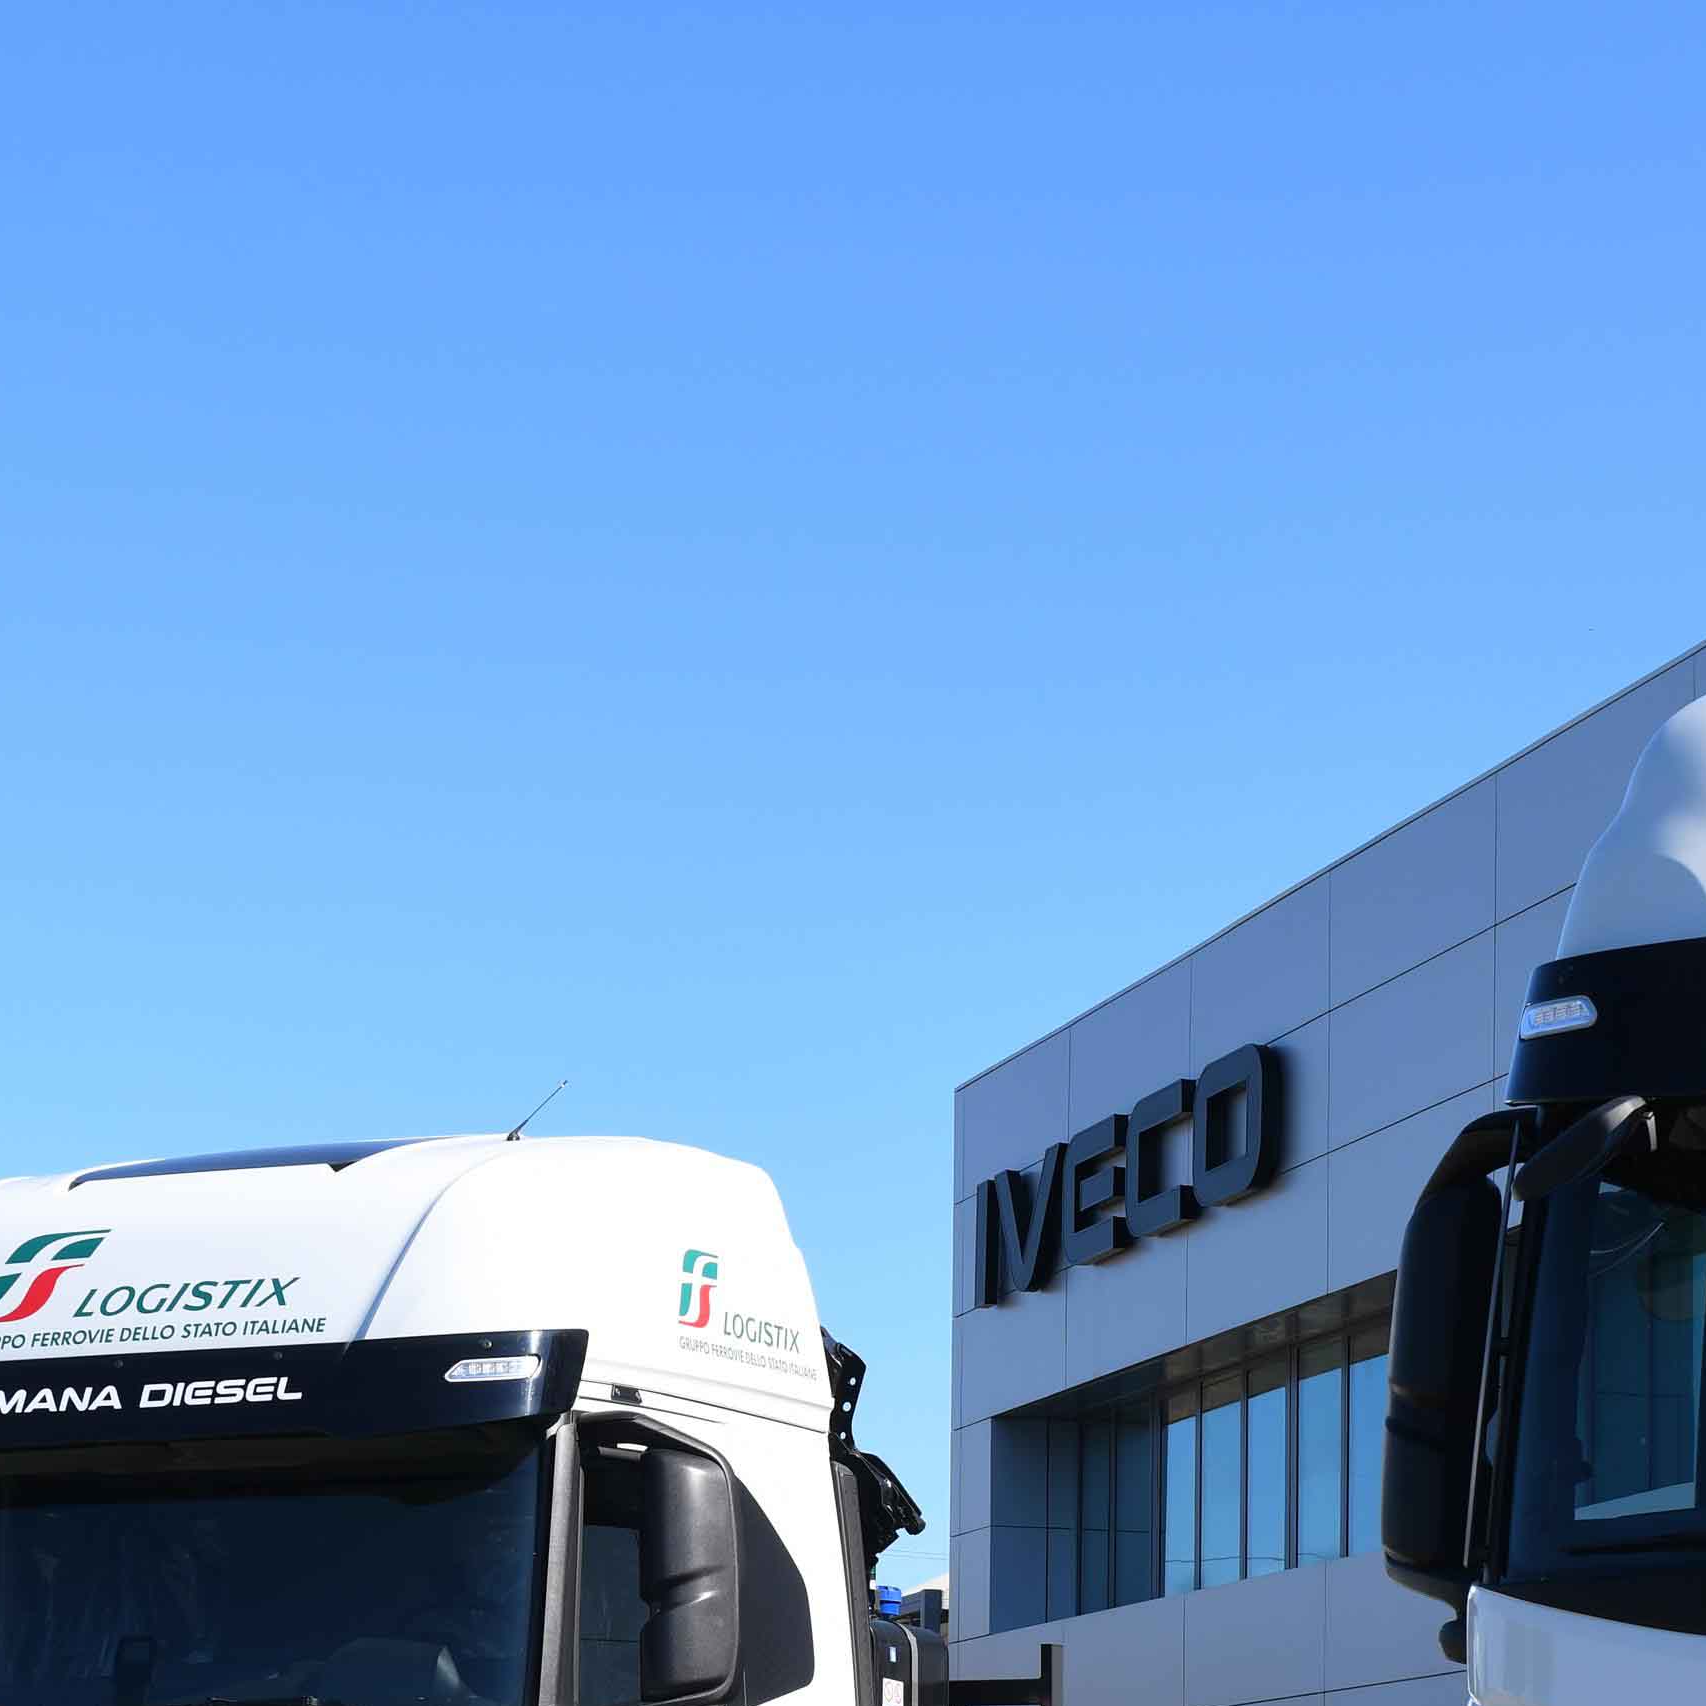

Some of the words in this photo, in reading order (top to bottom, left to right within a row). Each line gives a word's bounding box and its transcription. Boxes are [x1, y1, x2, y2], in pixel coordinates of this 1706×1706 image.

[975, 1044, 1278, 1308] IVECO
[73, 1277, 299, 1317] LOGISTIX
[31, 1329, 114, 1347] FERROVIE
[120, 1325, 174, 1341] DELLO
[181, 1322, 237, 1338] STATO
[243, 1318, 326, 1335] ITALIANE
[679, 1336, 710, 1354] GRUPPO
[711, 1344, 744, 1363] FERROVIE
[723, 1312, 800, 1354] LOGISTIX
[140, 1377, 302, 1408] DIESEL
